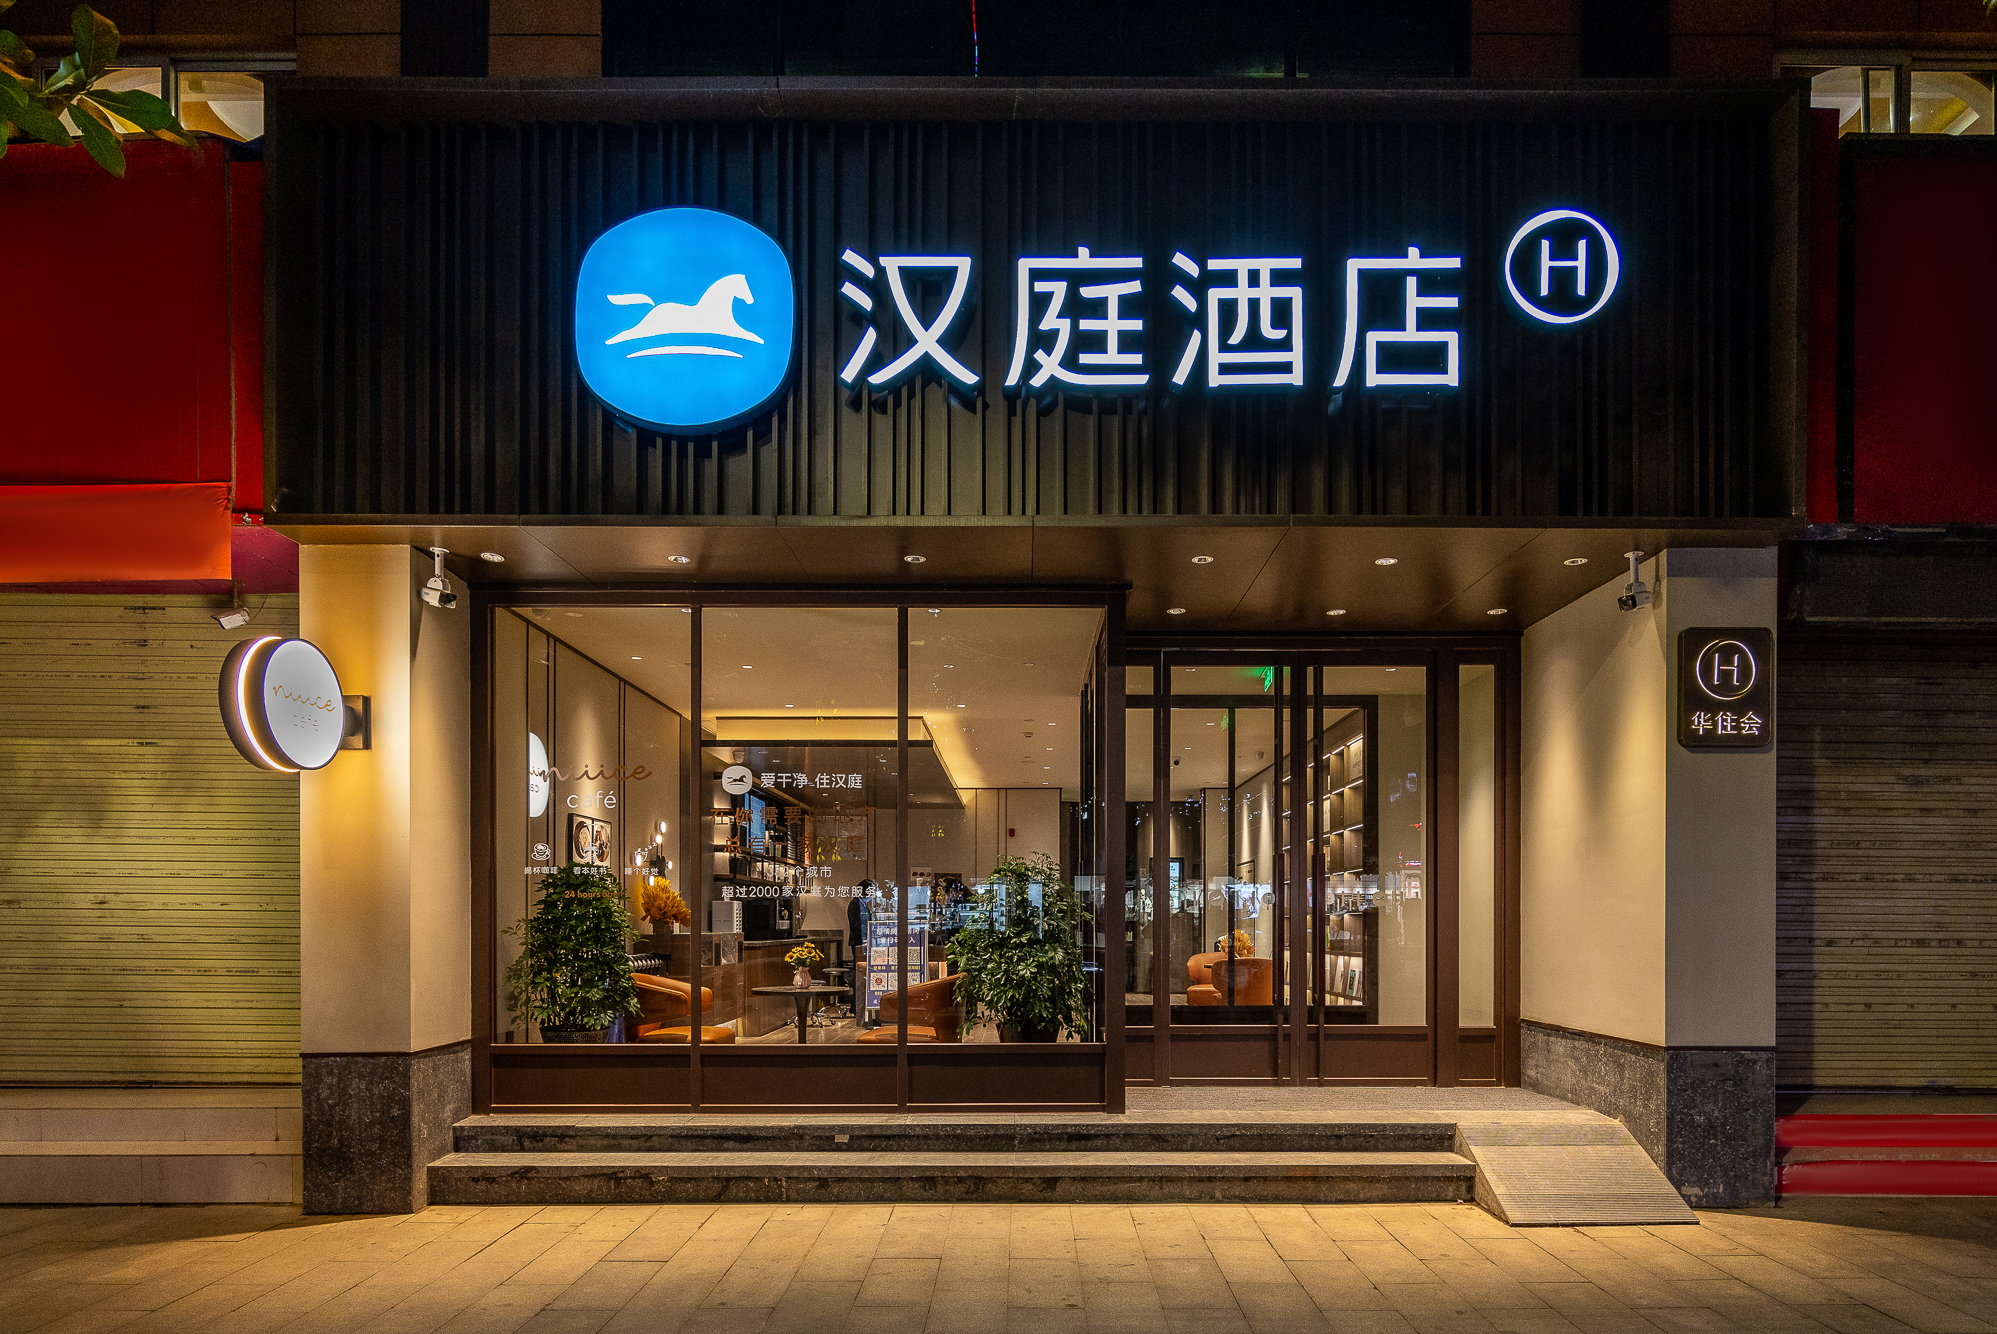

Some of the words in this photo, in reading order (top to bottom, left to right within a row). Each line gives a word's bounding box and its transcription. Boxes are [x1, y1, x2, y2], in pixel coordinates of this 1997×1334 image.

[838, 245, 1462, 388] 汉庭酒店
[1691, 711, 1763, 736] 华住会
[760, 772, 808, 789] 爱干净
[815, 772, 863, 789] 住汉庭
[566, 790, 617, 809] café
[710, 805, 876, 826] 在你需要的地方
[723, 835, 865, 854] 总有一家汉庭
[573, 866, 608, 875] 看本好书
[624, 867, 659, 876] 睡个好觉
[564, 890, 576, 899] 24
[577, 890, 601, 899] hours
[602, 892, 623, 900] open
[721, 885, 878, 899] 超过2000家汉庭为您服务
